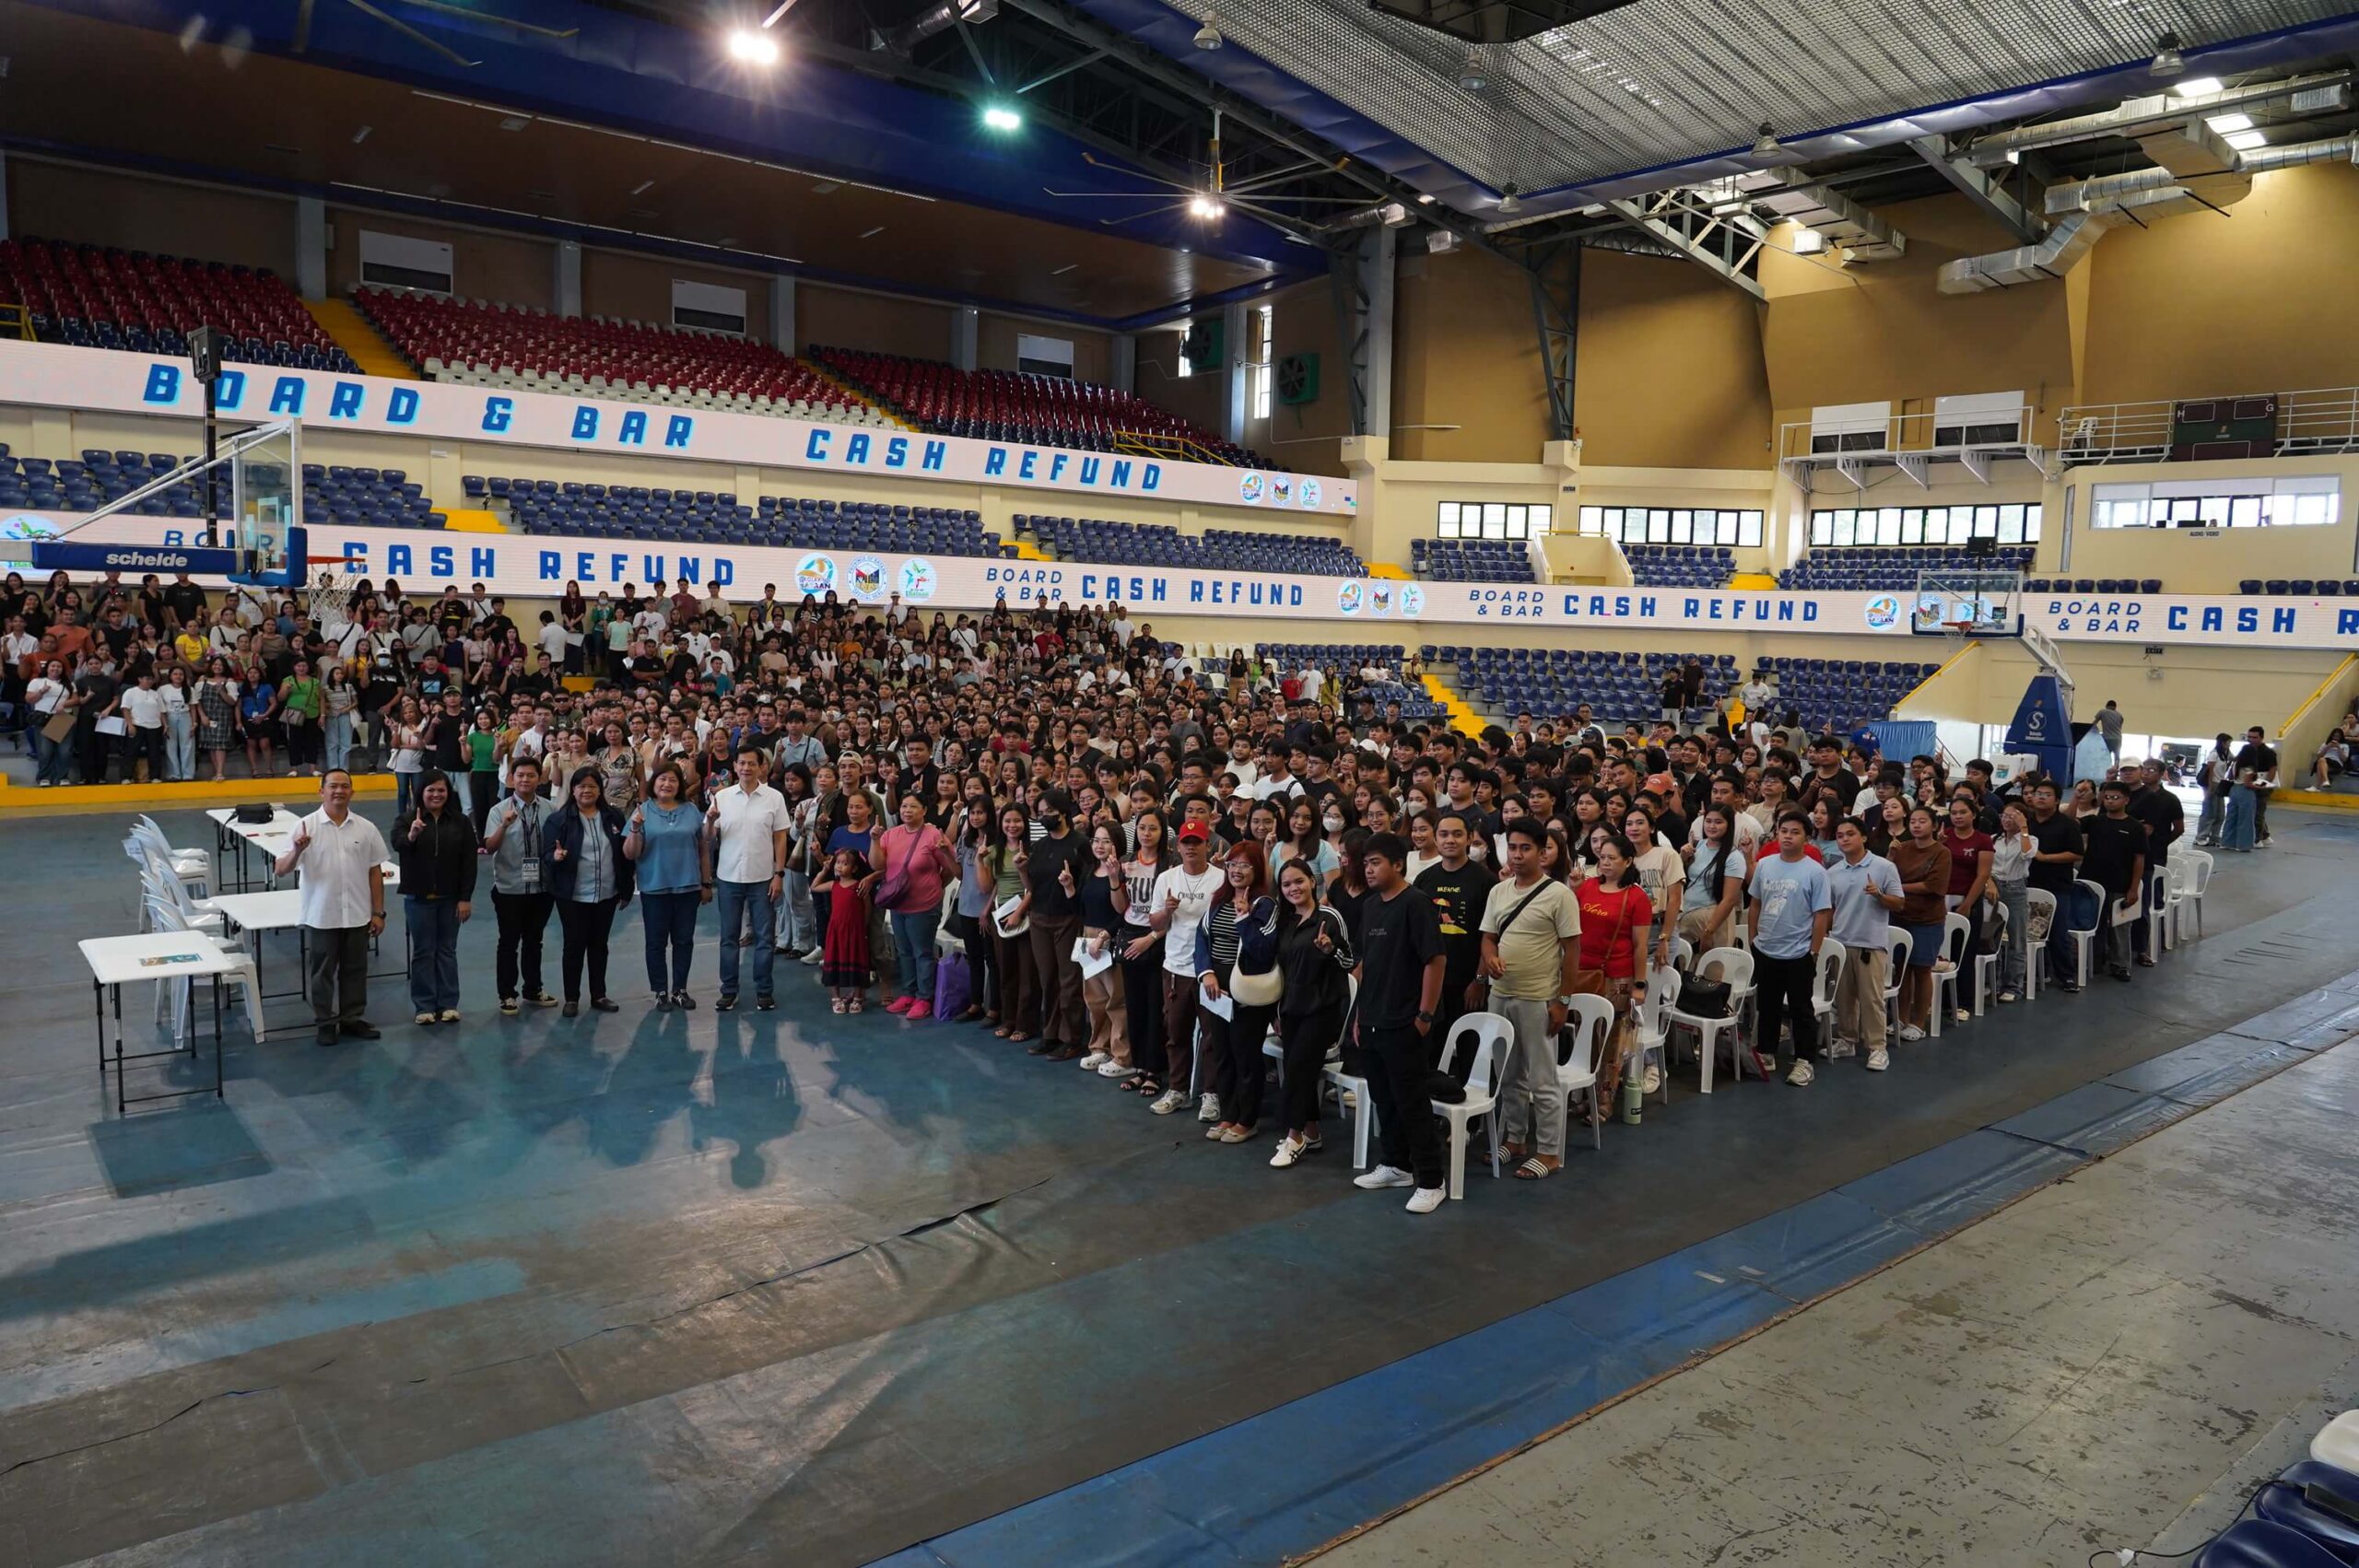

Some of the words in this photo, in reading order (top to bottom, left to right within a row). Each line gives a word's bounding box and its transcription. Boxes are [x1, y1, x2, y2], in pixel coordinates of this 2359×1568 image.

[2265, 404, 2274, 412] G
[143, 364, 420, 425] BOARD
[482, 397, 513, 433] &
[571, 405, 694, 448] BAR
[805, 428, 946, 471] CASH
[984, 447, 1161, 490] REFUND
[106, 552, 188, 567] schelde
[344, 542, 495, 578] CASH
[539, 551, 734, 586] REFUND
[988, 568, 1061, 583] BOARD
[995, 587, 1005, 599] &
[1020, 587, 1062, 600] BAR
[1082, 575, 1167, 601] CASH
[1190, 580, 1302, 605] REFUND
[1470, 590, 1543, 603] BOARD
[1478, 605, 1487, 615] &
[1502, 605, 1543, 616] BAR
[1565, 594, 1656, 616] CASH
[1684, 598, 1818, 621] REFUND
[2049, 602, 2142, 615] BOARD
[2059, 618, 2070, 631] &
[2087, 618, 2140, 632] BAR
[2168, 605, 2296, 633] CASH
